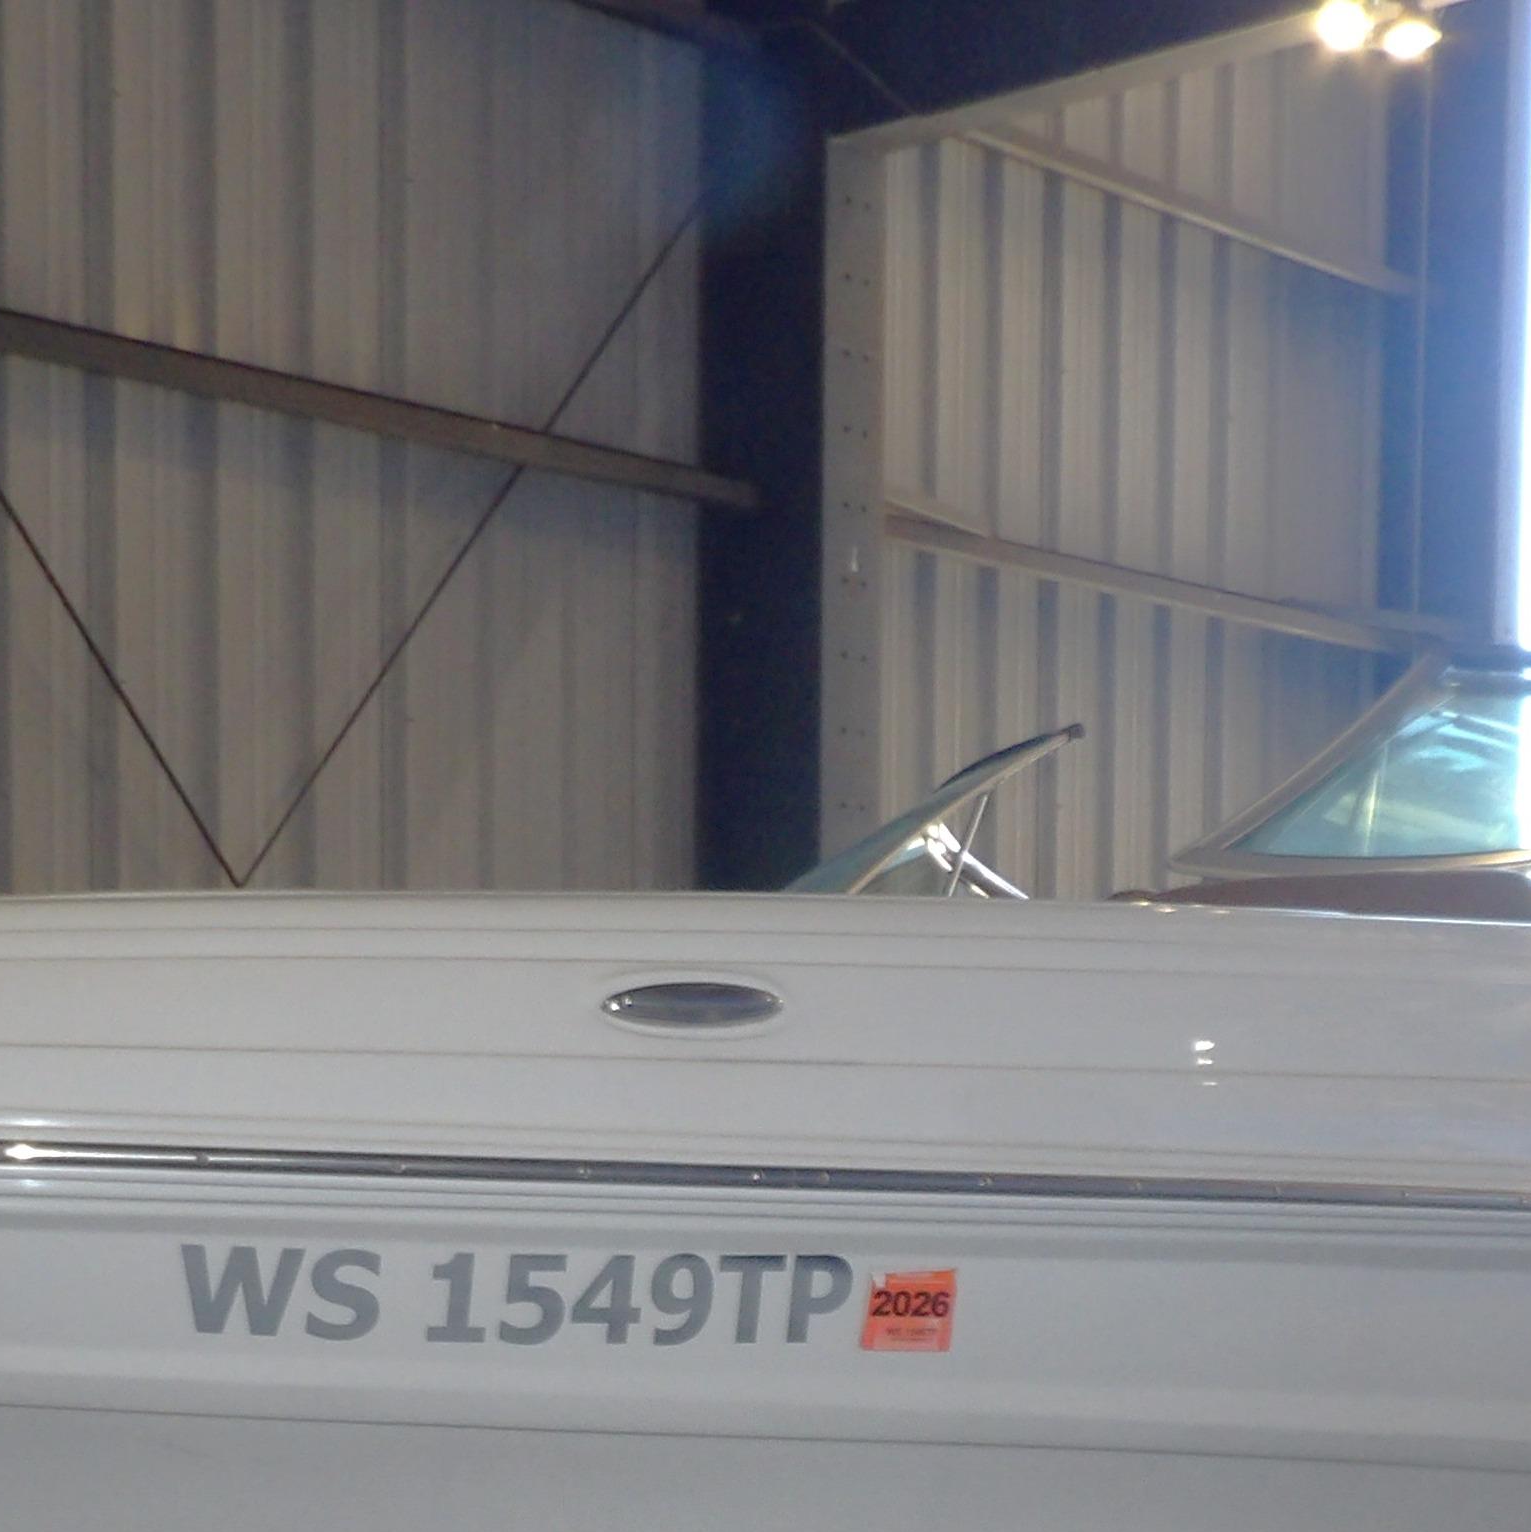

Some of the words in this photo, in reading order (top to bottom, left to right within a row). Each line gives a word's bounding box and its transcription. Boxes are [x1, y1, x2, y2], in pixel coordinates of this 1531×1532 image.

[180, 1244, 382, 1341] WS
[425, 1252, 855, 1346] 1549TP
[871, 1290, 950, 1318] 2026
